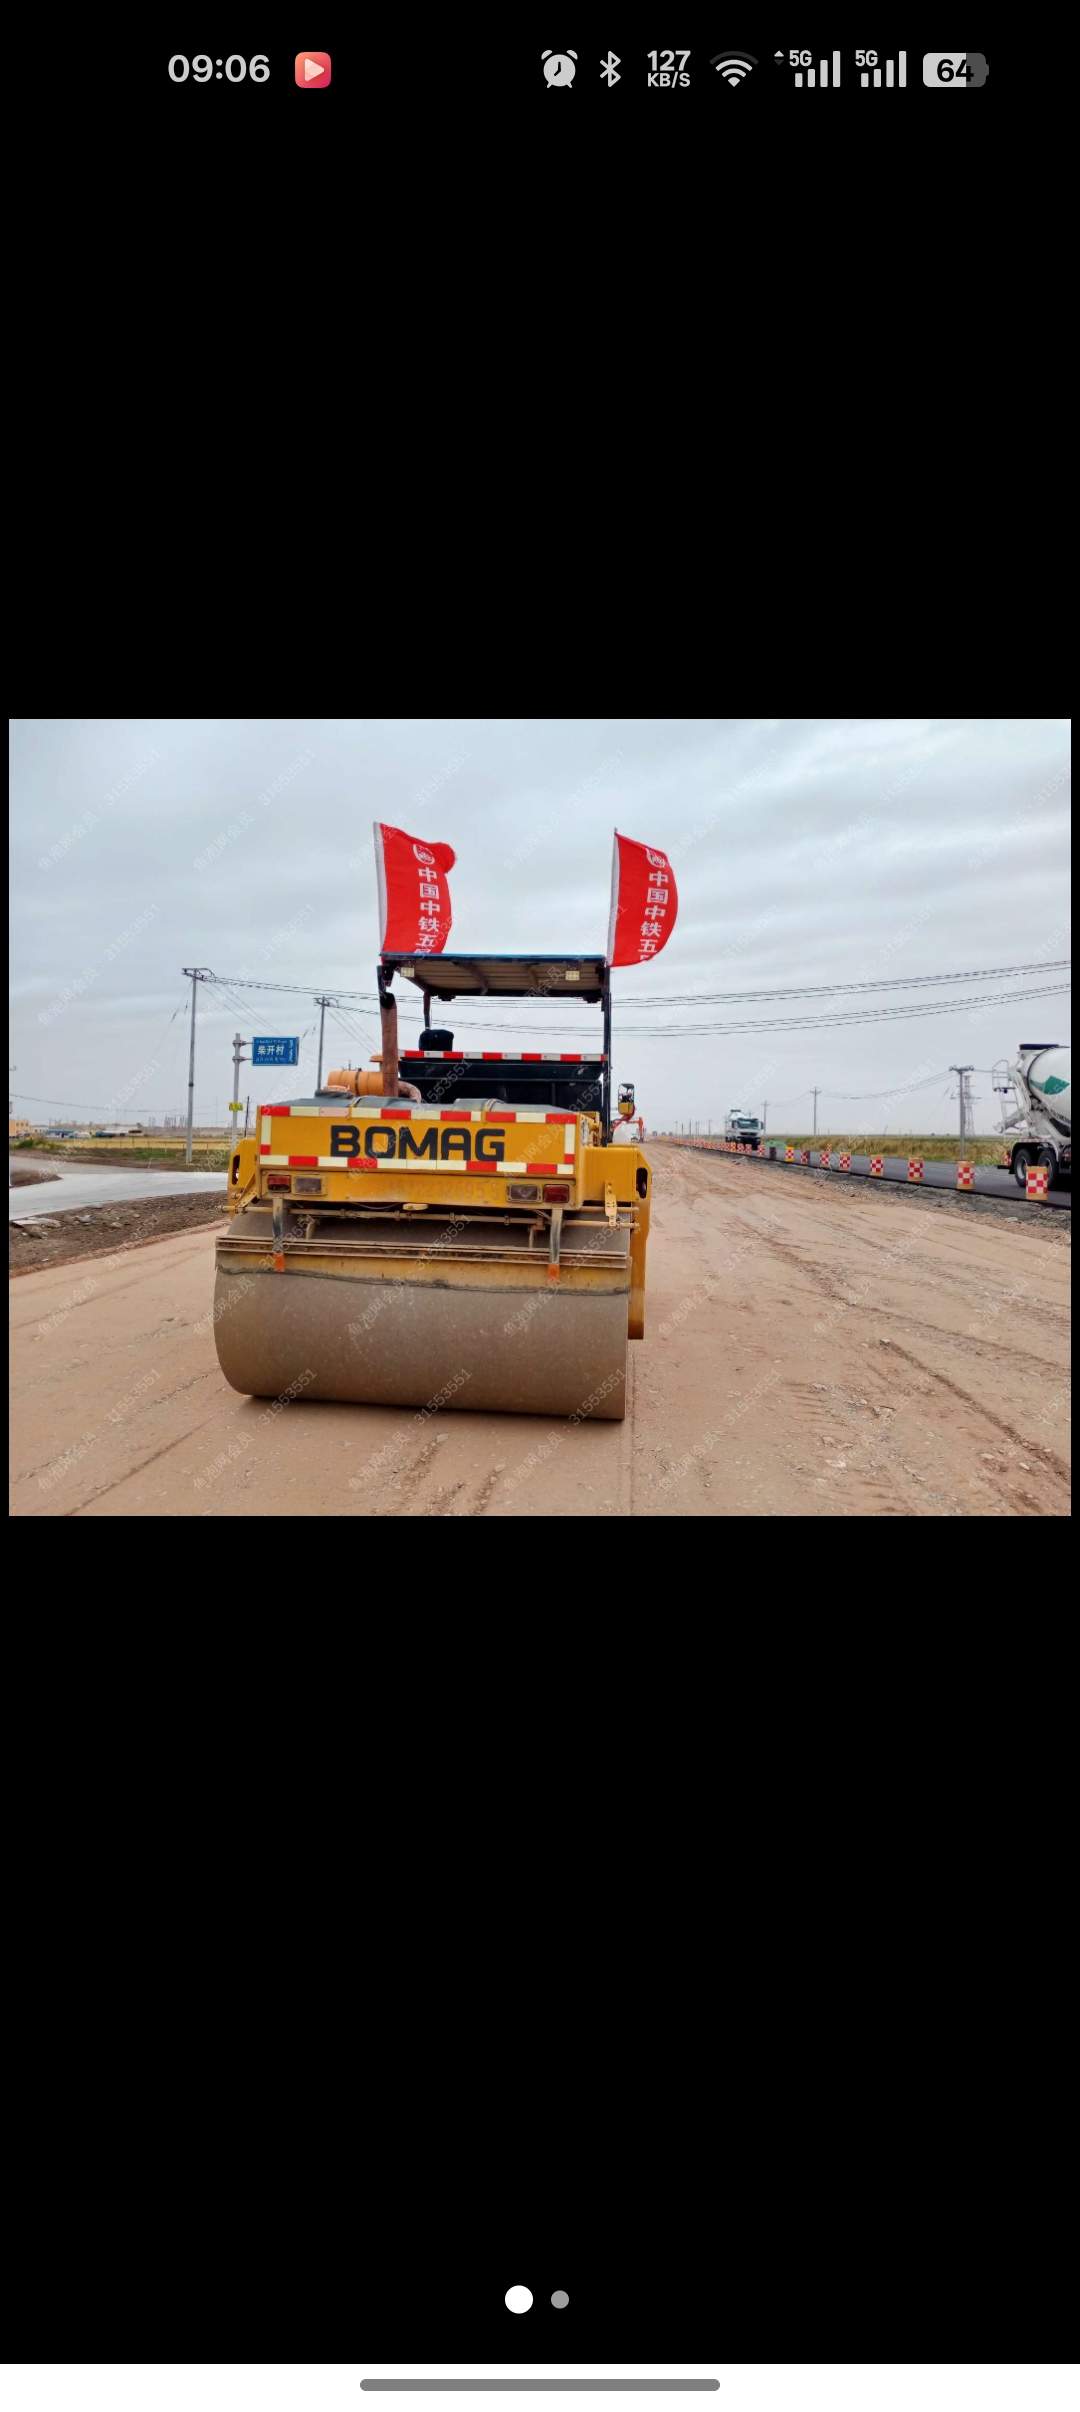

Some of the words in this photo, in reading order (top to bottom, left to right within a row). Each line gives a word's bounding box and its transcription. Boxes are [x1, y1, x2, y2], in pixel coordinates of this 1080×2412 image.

[168, 54, 271, 83] 09:06
[647, 50, 691, 72] 127
[789, 49, 813, 67] 5G
[855, 49, 879, 67] 5G
[648, 73, 691, 88] KB/S
[937, 58, 974, 83] 64
[331, 1125, 505, 1162] BOMAG
